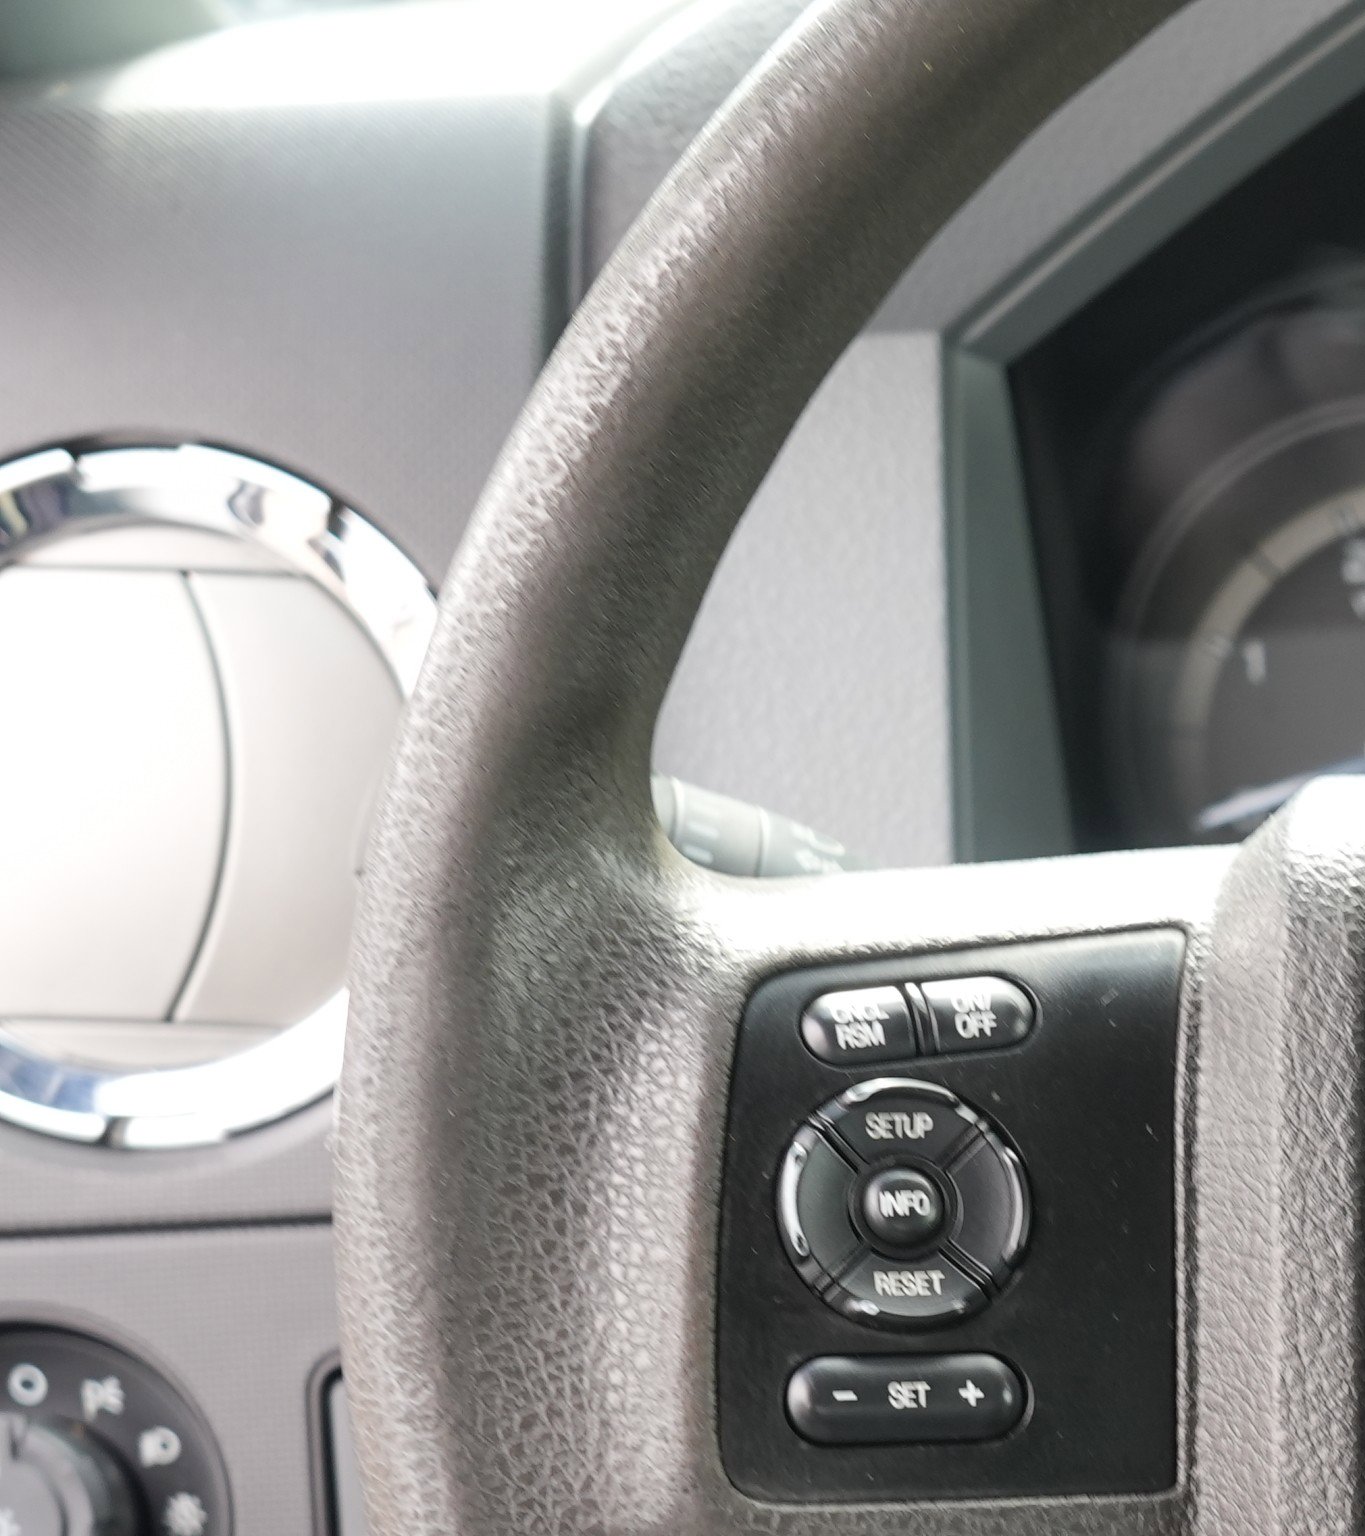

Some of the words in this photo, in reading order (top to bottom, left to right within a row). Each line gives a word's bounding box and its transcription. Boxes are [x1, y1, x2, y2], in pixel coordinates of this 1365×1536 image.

[1242, 639, 1267, 685] 1
[834, 1021, 886, 1050] RSM
[954, 1010, 998, 1039] OFF
[865, 1111, 934, 1140] SETUP
[879, 1189, 931, 1218] INFO
[873, 1269, 945, 1297] RESET
[887, 1380, 931, 1410] SET
